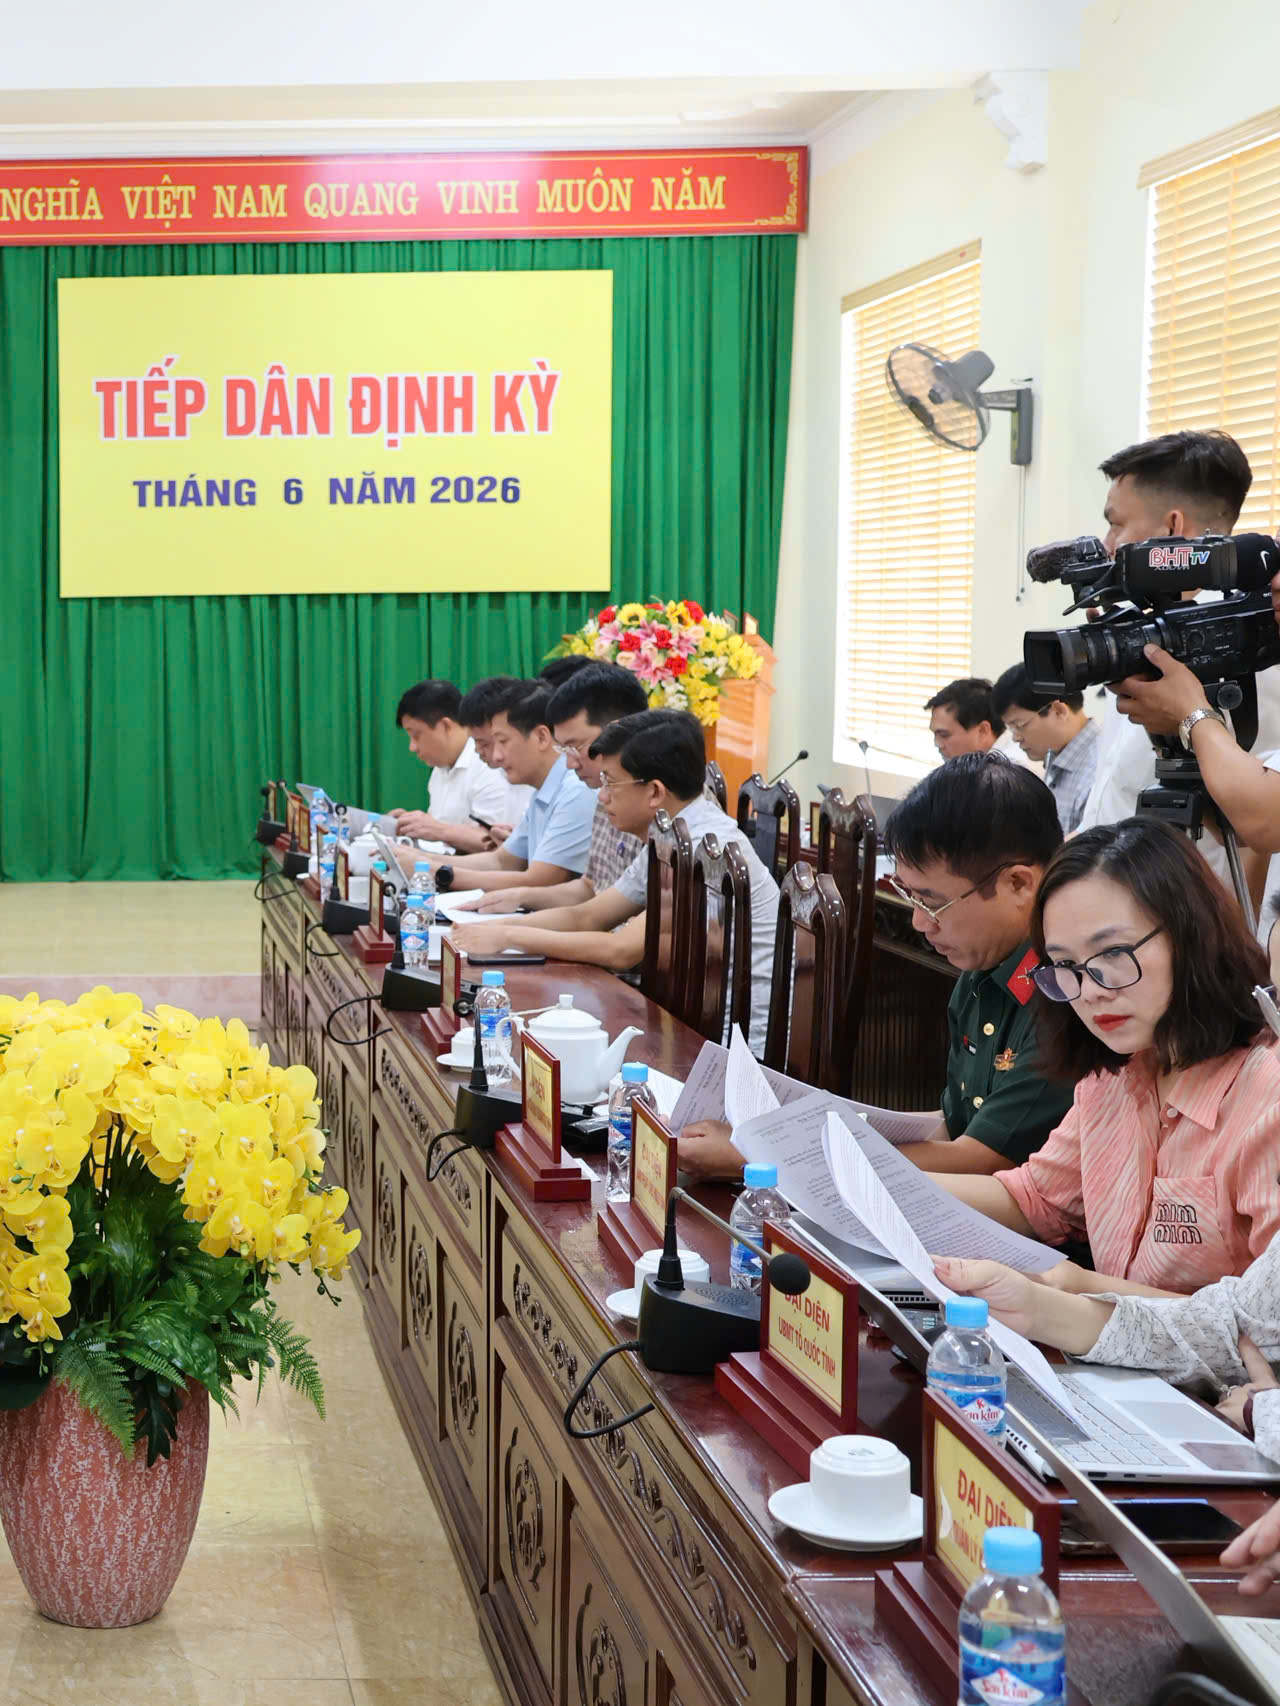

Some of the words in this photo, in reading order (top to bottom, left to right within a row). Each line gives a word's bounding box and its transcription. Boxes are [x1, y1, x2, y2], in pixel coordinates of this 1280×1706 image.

[0, 175, 104, 221] NGHĨA
[121, 175, 196, 228] VIỆT
[212, 184, 287, 218] NAM
[303, 181, 420, 217] QUANG
[437, 179, 520, 214] VINH
[536, 168, 633, 212] MUÔN
[650, 165, 726, 211] NĂM
[93, 354, 206, 439] TIẾP
[223, 363, 332, 438] DÂN
[349, 373, 475, 449] ĐỊNH
[492, 360, 561, 435] KỲ
[133, 473, 257, 507] THÁNG
[283, 479, 303, 505] 6
[329, 471, 416, 504] NĂM
[429, 476, 521, 504] 2026
[805, 1297, 830, 1333] DIỆN
[779, 1315, 794, 1345] UBMT
[795, 1322, 802, 1351] TỔ
[804, 1337, 820, 1366] QUỐC
[822, 1345, 836, 1378] TỈNH
[958, 1468, 981, 1521] ĐẠI
